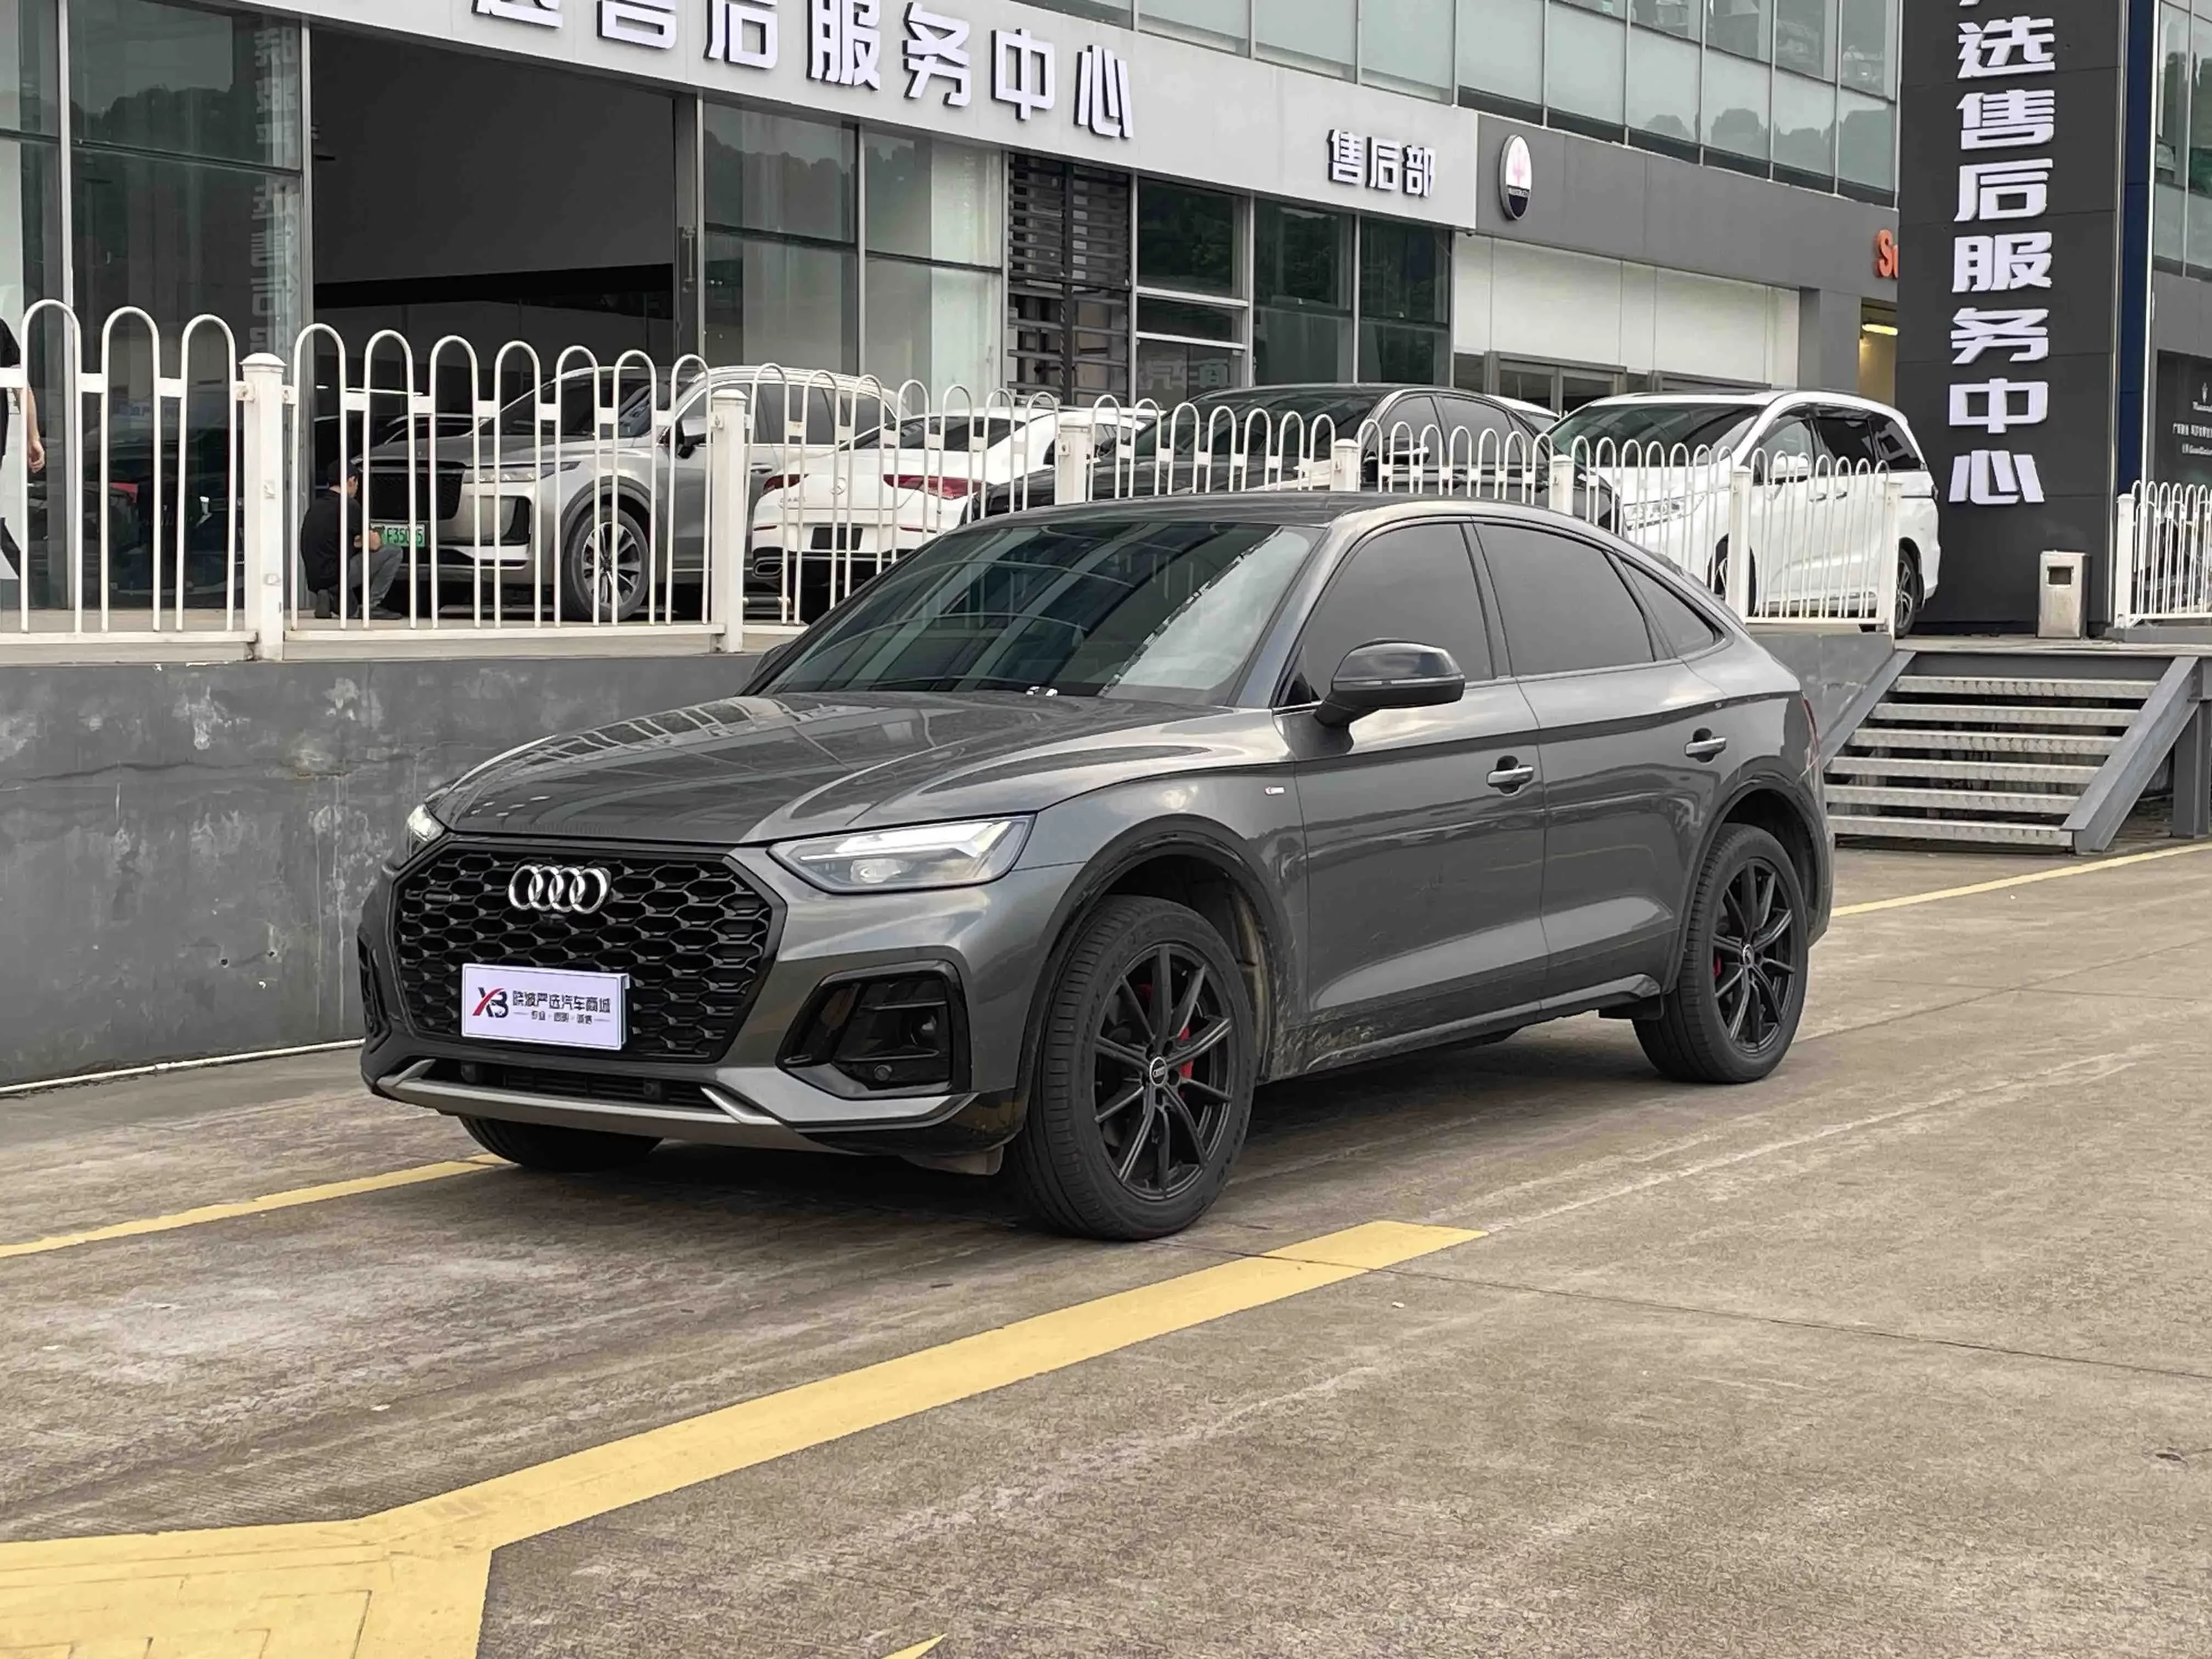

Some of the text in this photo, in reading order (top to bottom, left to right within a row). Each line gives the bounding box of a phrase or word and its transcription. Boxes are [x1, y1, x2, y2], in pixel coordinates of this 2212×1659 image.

[471, 0, 1133, 139] 后服务中心
[1327, 128, 1436, 198] 售后部
[1949, 0, 2056, 506] 选售后服务中心
